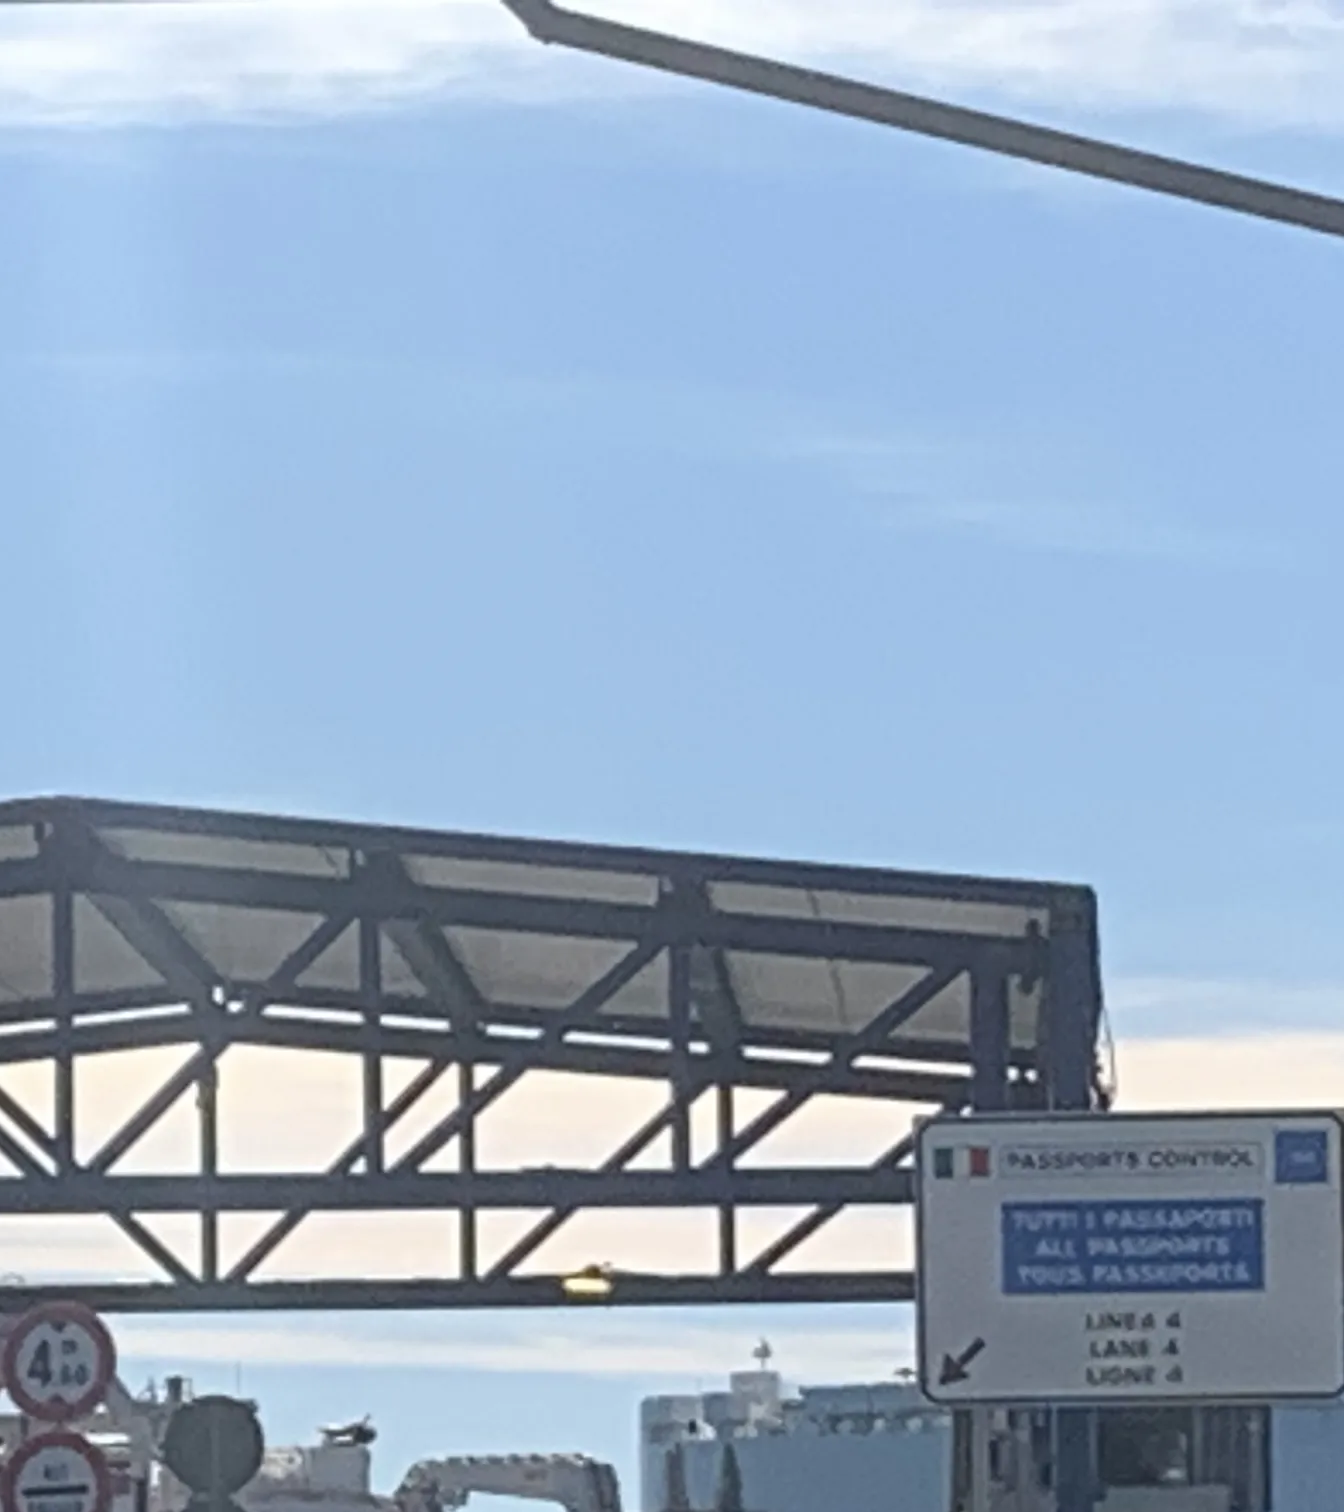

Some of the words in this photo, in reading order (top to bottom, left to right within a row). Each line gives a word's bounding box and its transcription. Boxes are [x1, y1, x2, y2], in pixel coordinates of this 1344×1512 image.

[1007, 1150, 1140, 1171] PASSPORTS
[1147, 1148, 1255, 1169] CONTROL
[1011, 1210, 1079, 1231] TUTTI
[1085, 1210, 1096, 1231] I
[1102, 1208, 1255, 1230] PASSAPORTI
[1035, 1238, 1077, 1258] ALL
[1086, 1237, 1231, 1257] PASSPORTS
[1016, 1264, 1086, 1285] TOUS
[1085, 1311, 1156, 1331] LINEA
[1164, 1311, 1182, 1330] 4
[1089, 1338, 1150, 1358] LANE
[1160, 1337, 1180, 1357] 4
[25, 1339, 53, 1390] 4
[1085, 1364, 1156, 1387] LIGNE
[1164, 1363, 1184, 1385] 4
